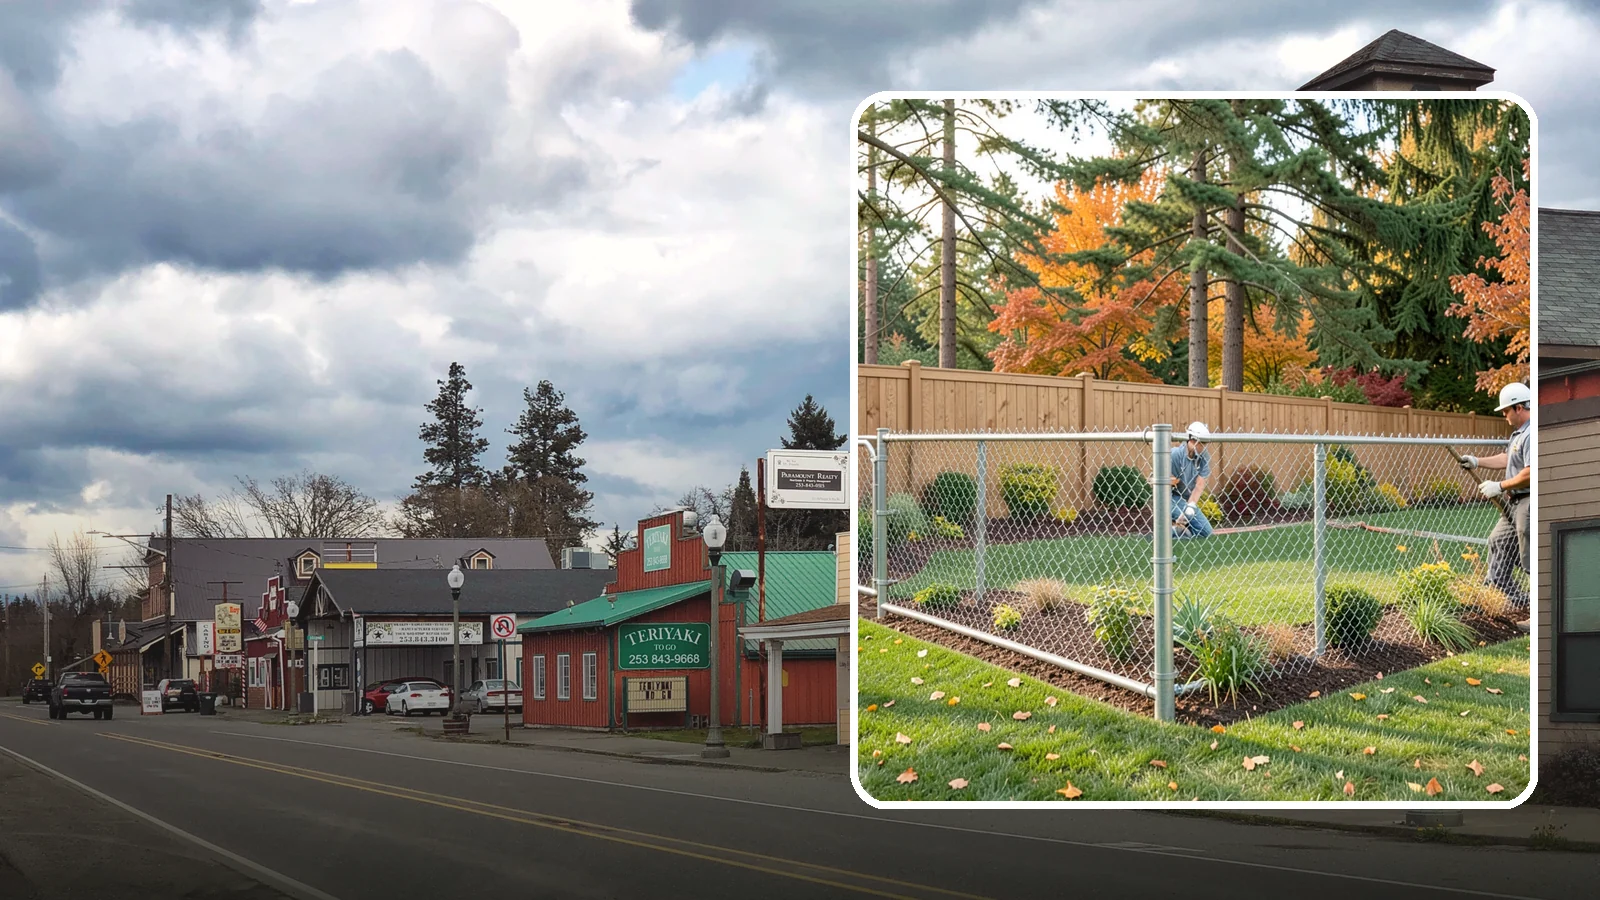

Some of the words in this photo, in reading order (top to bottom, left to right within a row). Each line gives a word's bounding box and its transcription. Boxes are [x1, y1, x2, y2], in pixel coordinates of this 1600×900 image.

[781, 471, 815, 479] PARAMOUNT
[817, 472, 839, 480] REALTY
[646, 530, 669, 549] TERIYAKI
[624, 627, 702, 646] TERIYAKI
[628, 654, 649, 665] 253
[651, 653, 700, 664] 843-9668
